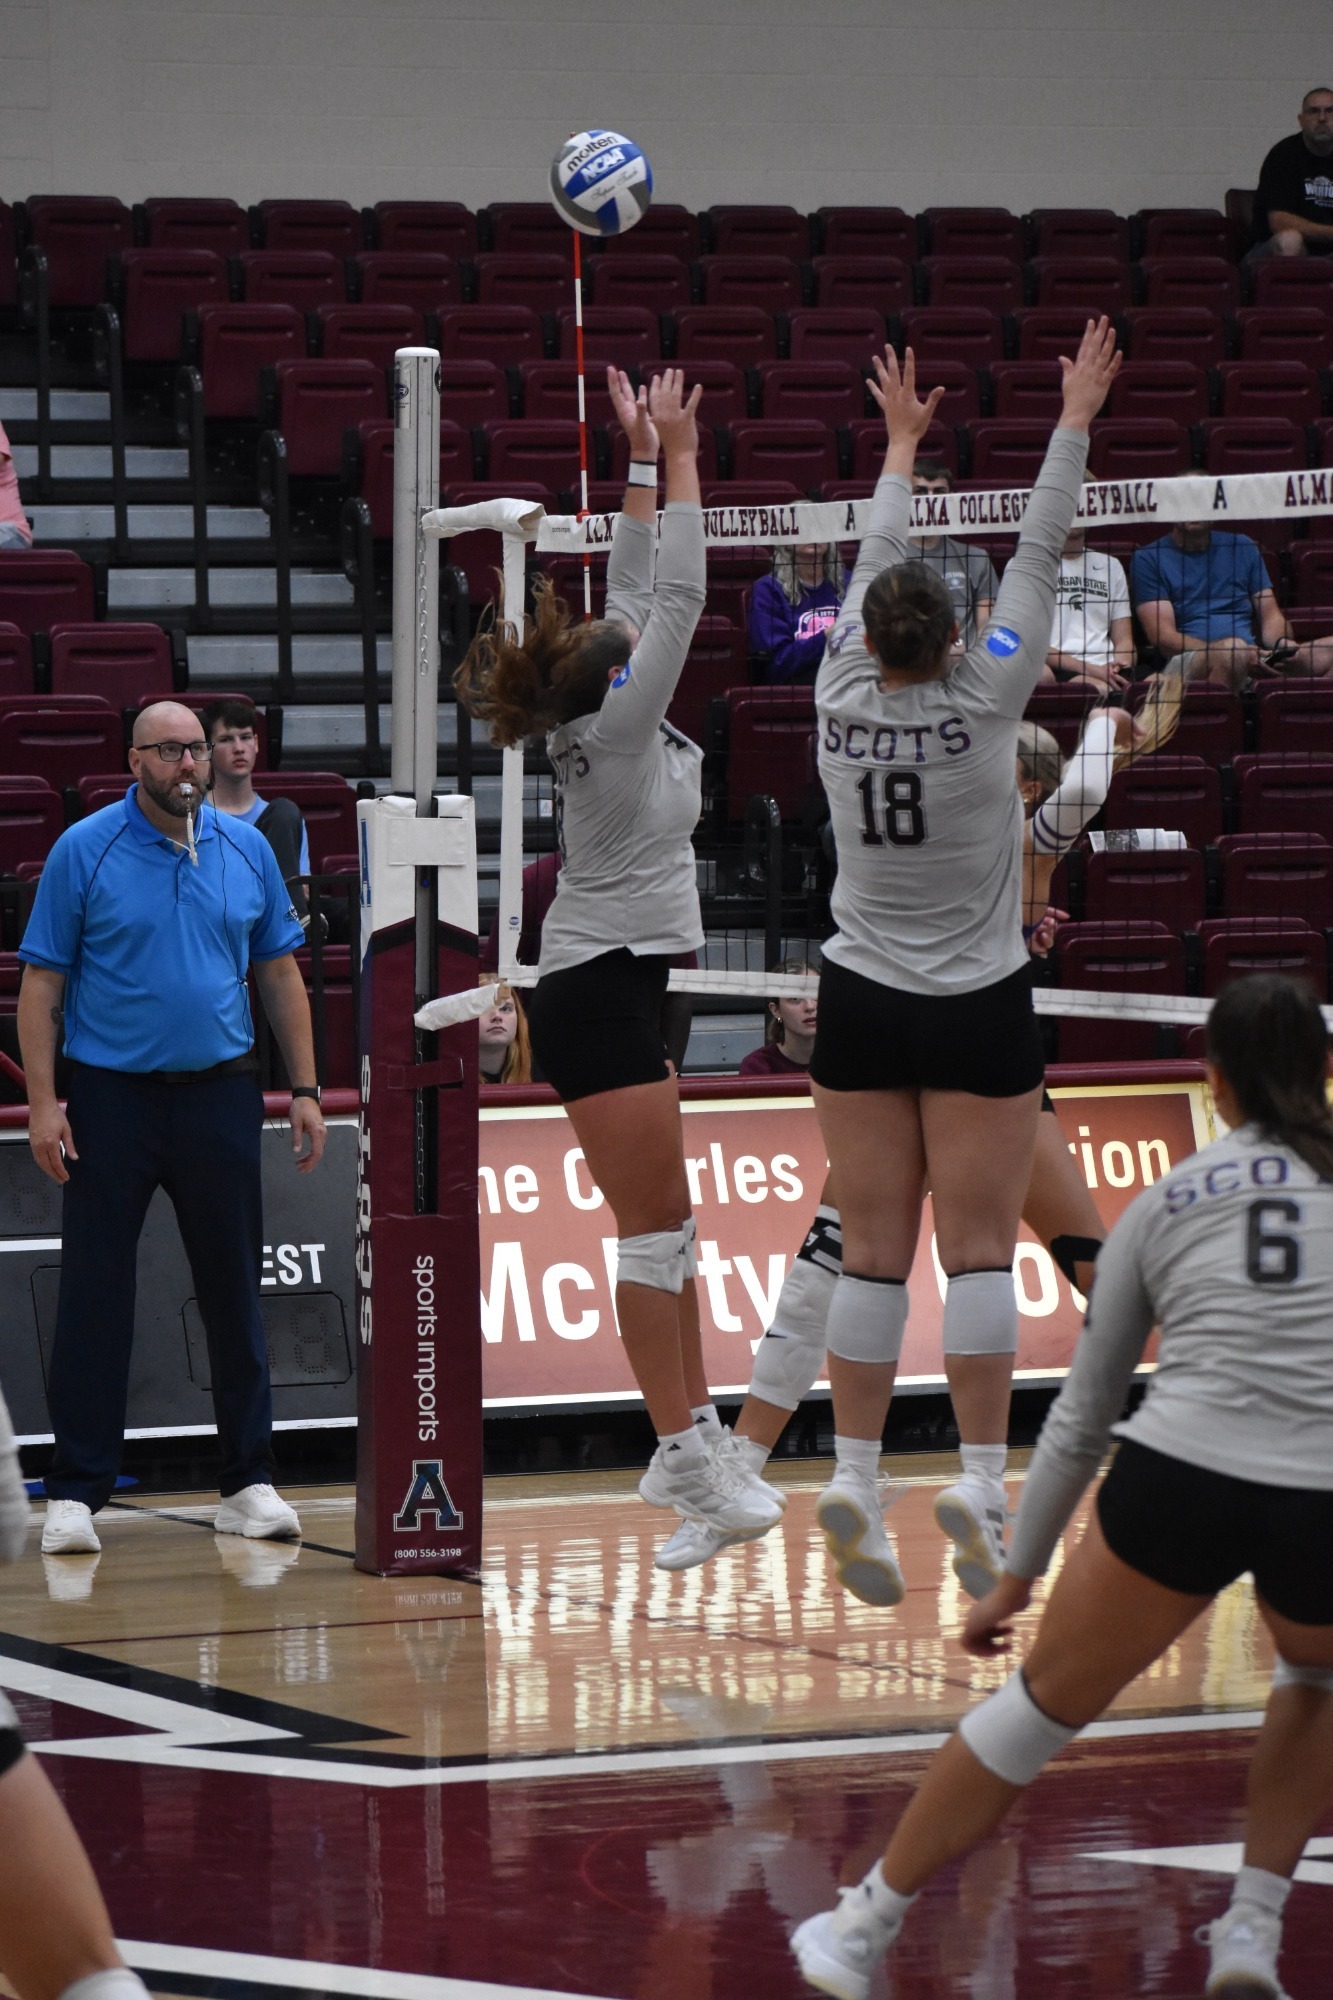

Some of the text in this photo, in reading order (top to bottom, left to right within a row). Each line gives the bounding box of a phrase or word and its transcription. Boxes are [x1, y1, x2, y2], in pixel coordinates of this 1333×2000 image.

[567, 135, 618, 172] molten
[581, 147, 625, 184] NCAA
[1076, 481, 1158, 518] LEYBALL
[1212, 479, 1228, 509] A
[702, 507, 799, 537] VOLLEYBALL
[845, 503, 856, 531] A
[824, 715, 972, 764] SCOTS
[855, 769, 928, 849] 18
[562, 1139, 804, 1212] Crles
[1162, 1154, 1289, 1216] SCO
[1244, 1195, 1303, 1286] 6
[260, 1243, 326, 1286] EST
[411, 1255, 440, 1442] sports imports
[393, 1459, 464, 1532] A
[394, 1548, 462, 1559] (800) 556-3198
